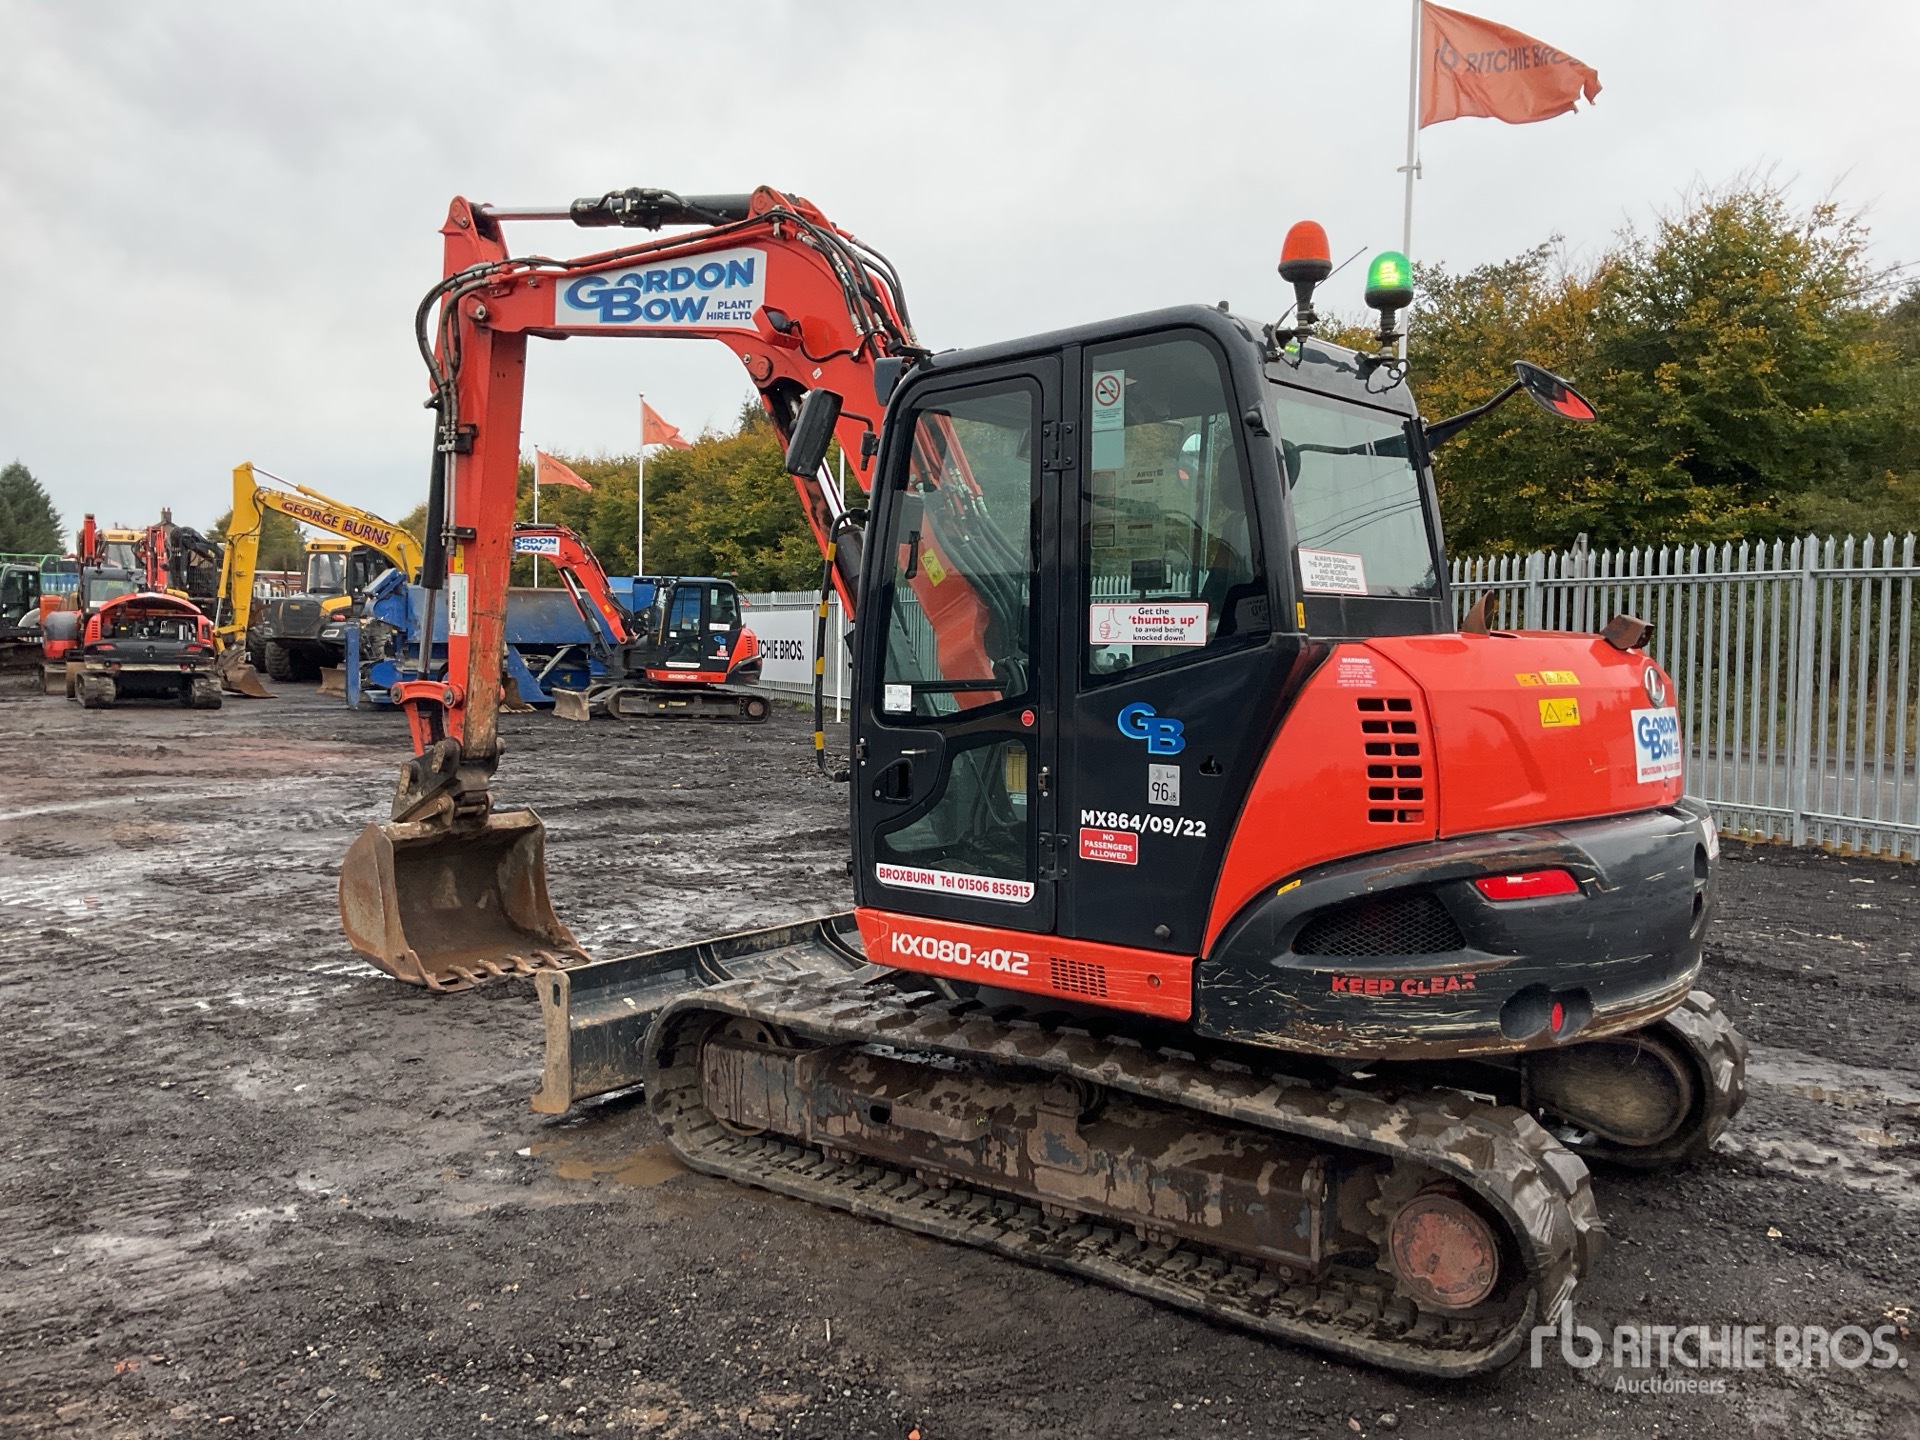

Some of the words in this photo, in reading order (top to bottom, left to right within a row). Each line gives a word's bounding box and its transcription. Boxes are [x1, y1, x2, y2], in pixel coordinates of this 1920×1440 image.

[1464, 46, 1531, 73] RITCHIE
[564, 257, 755, 311] GORDON
[600, 287, 709, 324] BOW
[717, 300, 753, 310] PLANT
[706, 311, 731, 321] HIRE
[732, 311, 752, 321] LTD
[281, 501, 341, 528] GEORGE
[341, 519, 391, 546] BURNS
[1138, 607, 1153, 615] Get
[1155, 607, 1170, 615] the
[1164, 626, 1184, 635] being
[780, 640, 805, 660] BROS.
[1117, 702, 1186, 755] GB
[1081, 809, 1207, 837] MX864/09/22
[1084, 840, 1133, 852] PASSENGERS
[1102, 833, 1115, 841] NO
[1089, 850, 1127, 860] ALLOWED
[879, 867, 935, 885] BROXBURN
[940, 875, 955, 888] Tel
[957, 878, 990, 892] 01506
[992, 882, 1030, 898] 855913
[1331, 976, 1395, 994] KEEP
[1401, 972, 1476, 995] CLEAR
